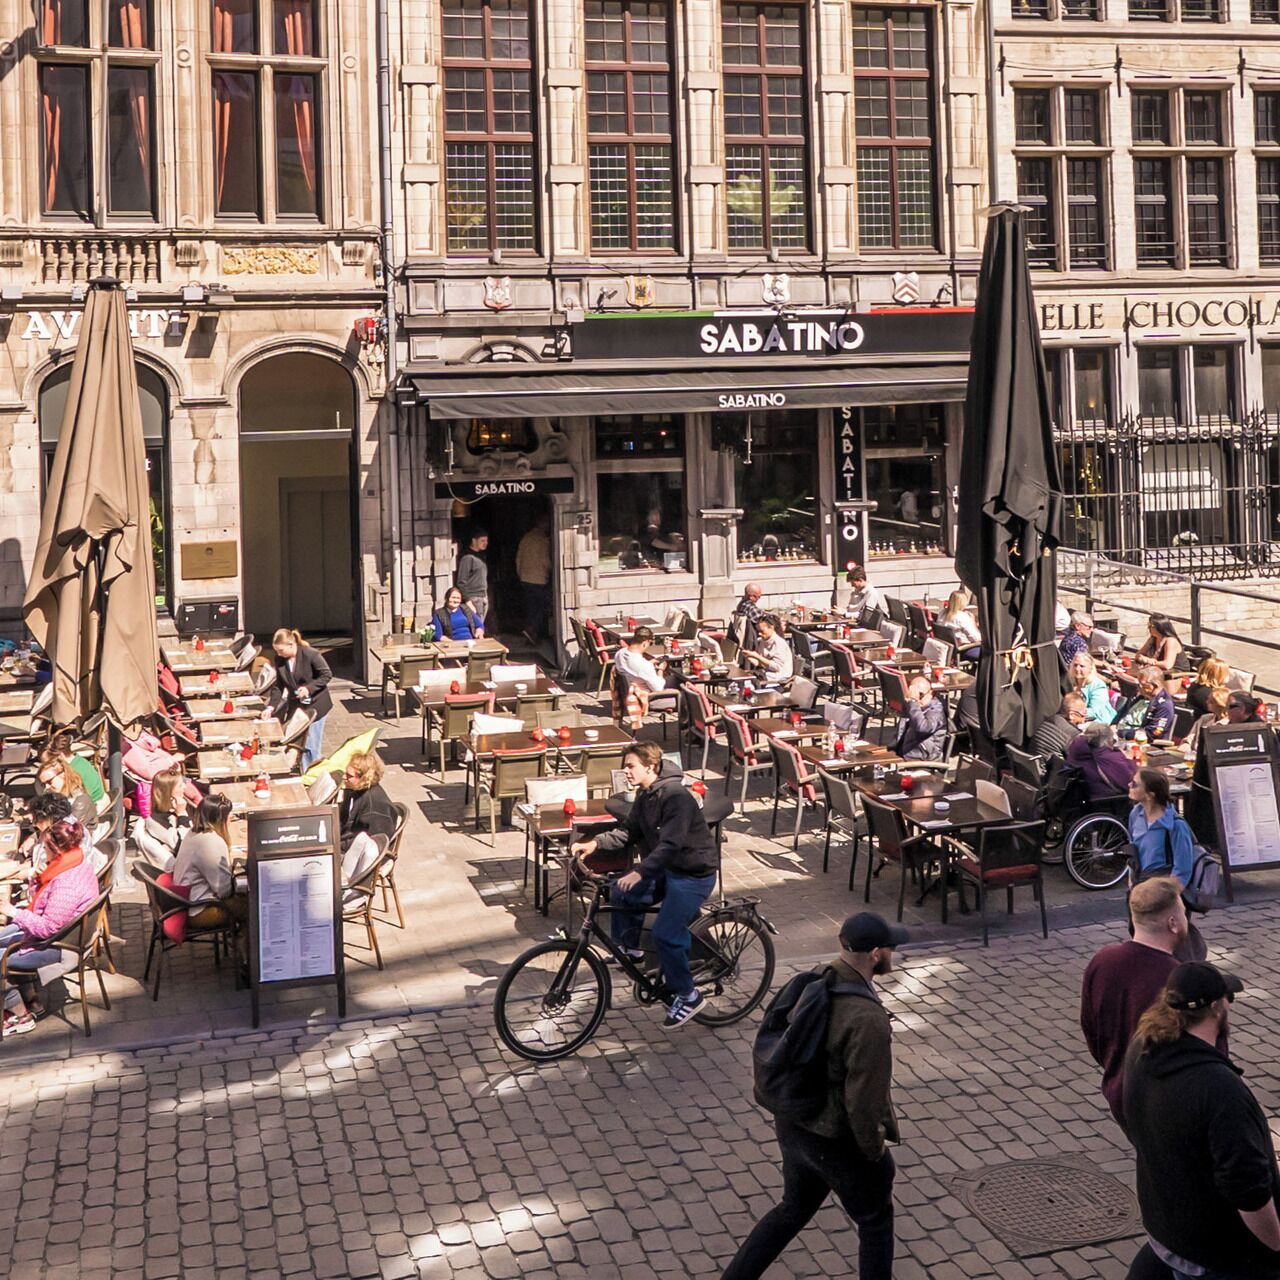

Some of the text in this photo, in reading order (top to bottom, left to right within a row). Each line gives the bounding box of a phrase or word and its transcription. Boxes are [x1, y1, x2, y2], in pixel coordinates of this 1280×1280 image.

[700, 321, 865, 353] SABATINO
[718, 393, 786, 408] SABATINO
[840, 406, 859, 541] SABATINO
[474, 482, 536, 495] SABATINO
